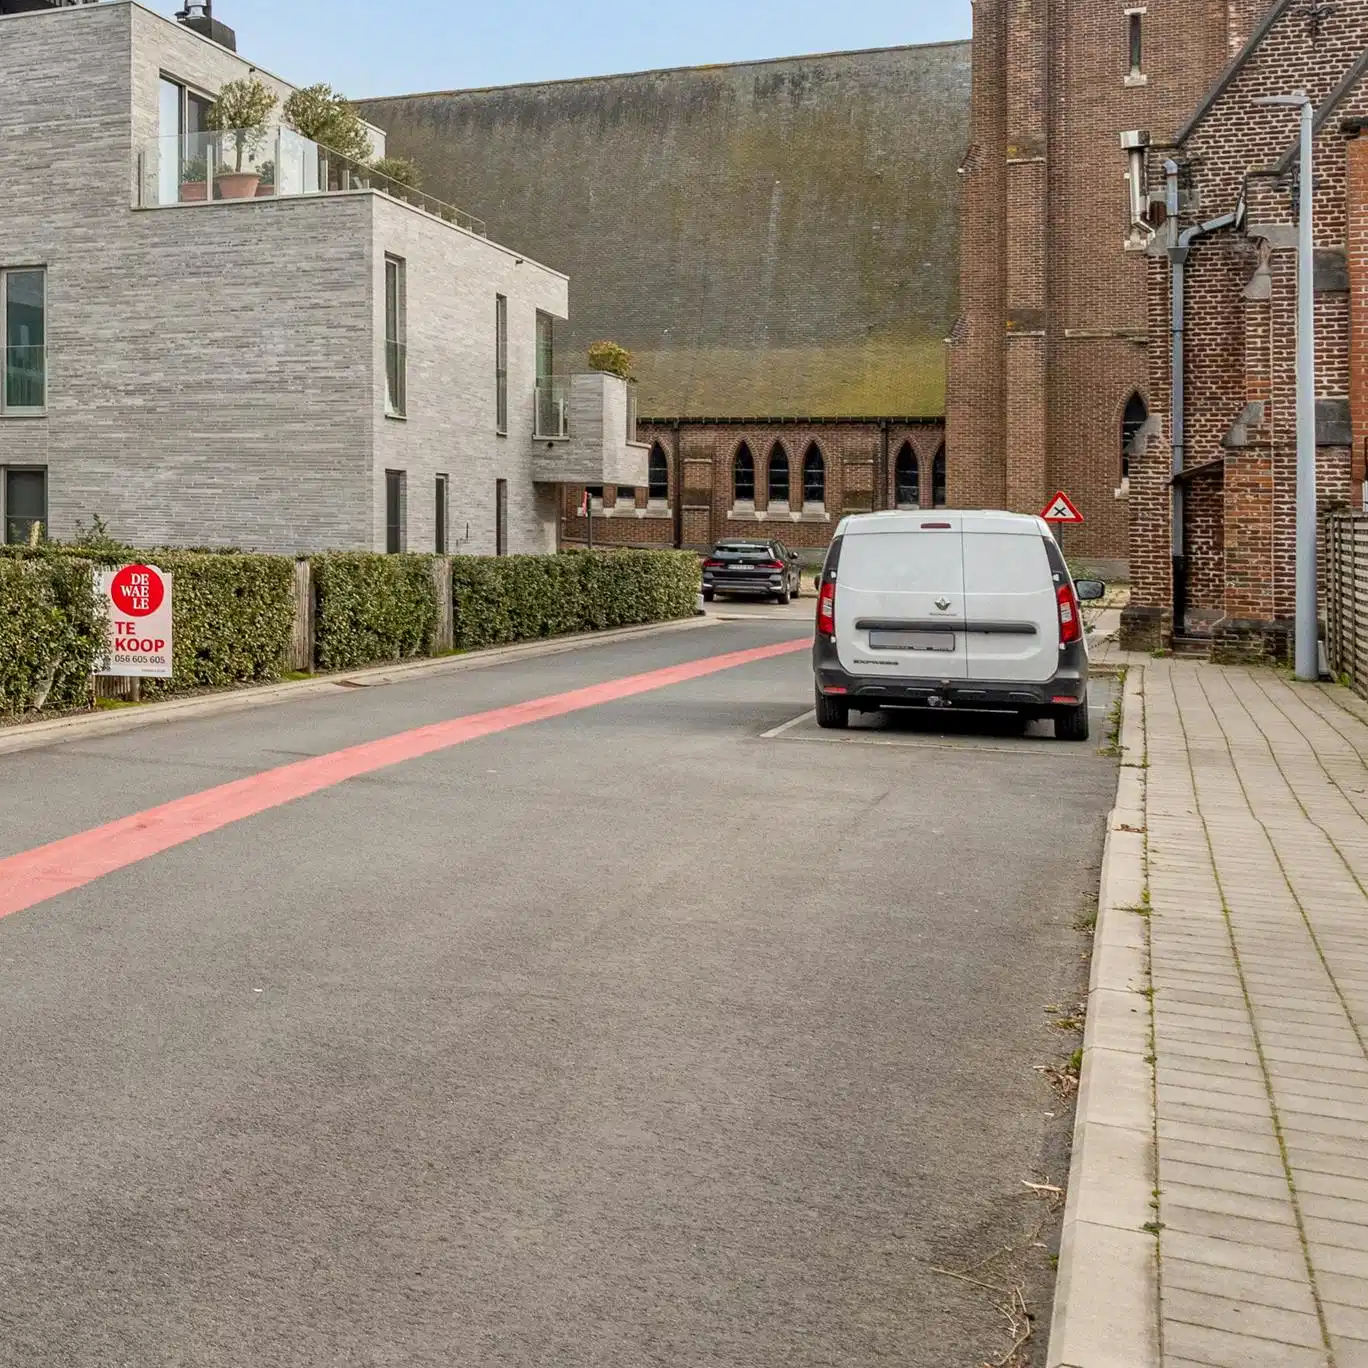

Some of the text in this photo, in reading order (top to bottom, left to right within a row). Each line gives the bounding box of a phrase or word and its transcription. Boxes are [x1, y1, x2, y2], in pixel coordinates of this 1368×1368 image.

[131, 573, 150, 585] DE
[120, 585, 150, 598] WAE
[132, 598, 150, 610] LE
[114, 621, 136, 635] TE
[115, 638, 165, 653] KOOP
[114, 654, 166, 664] 056 605 605
